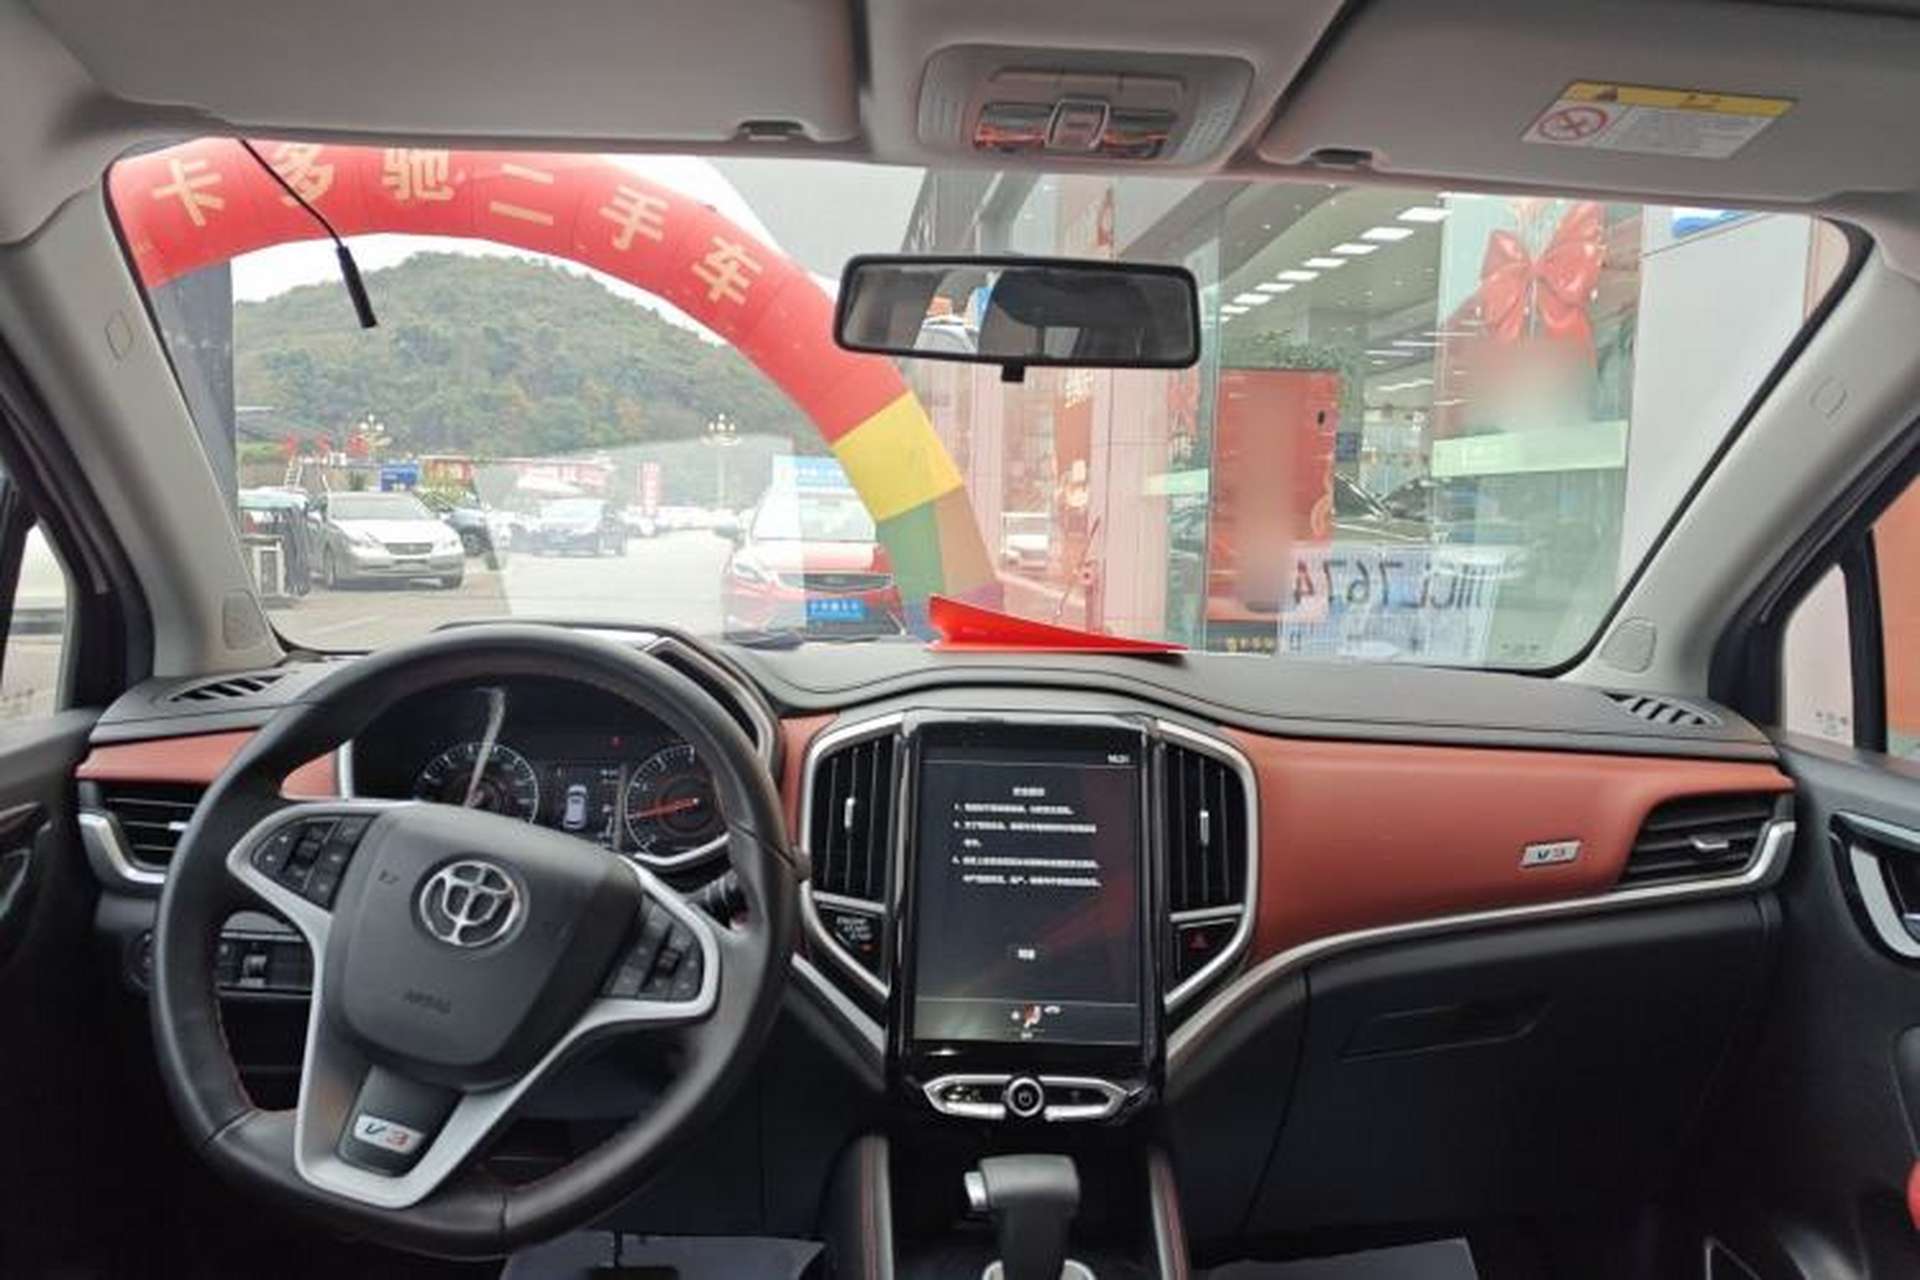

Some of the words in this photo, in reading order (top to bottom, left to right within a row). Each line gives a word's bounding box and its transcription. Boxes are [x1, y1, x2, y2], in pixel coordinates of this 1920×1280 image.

[152, 143, 763, 304] 卡多驰二手车
[365, 1122, 410, 1147] V3
